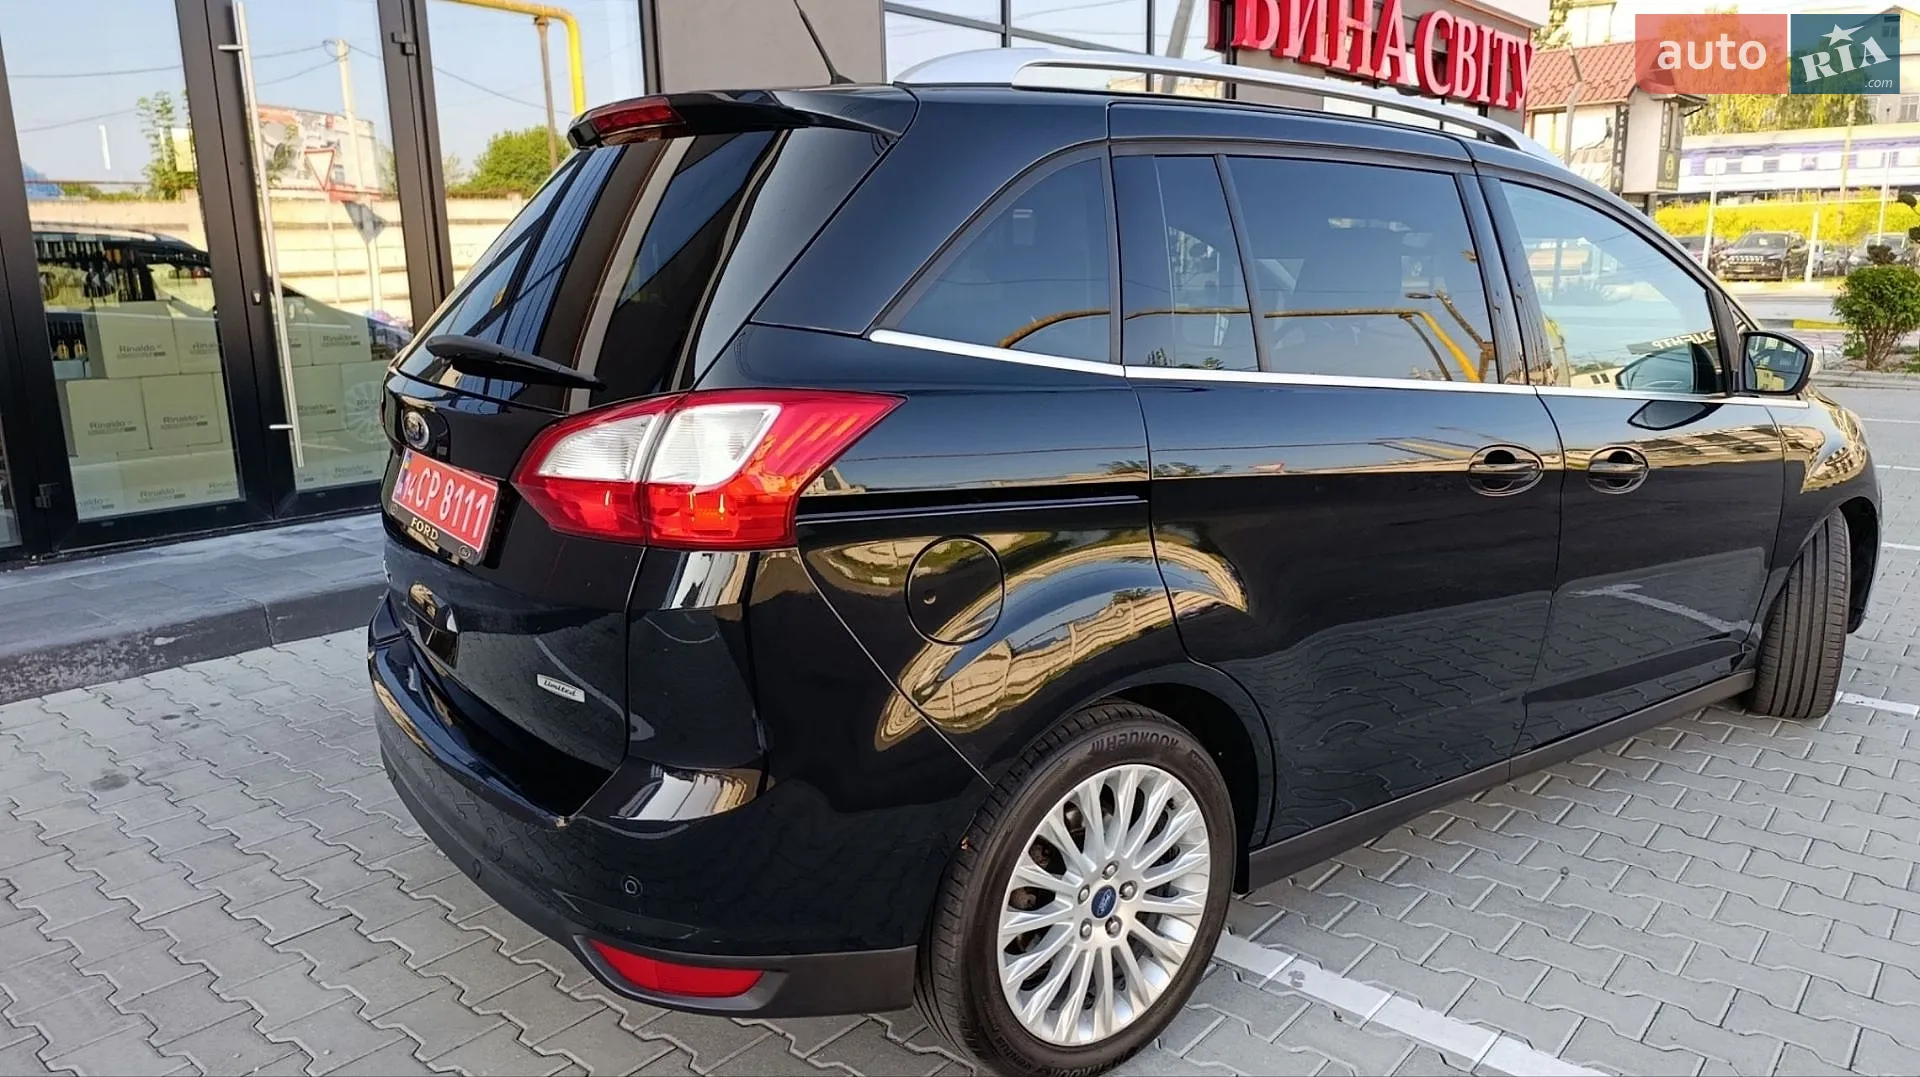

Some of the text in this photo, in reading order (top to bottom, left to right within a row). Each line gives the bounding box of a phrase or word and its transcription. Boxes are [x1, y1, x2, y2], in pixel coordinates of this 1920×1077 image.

[1417, 9, 1536, 109] СВІТУ
[118, 343, 156, 353] Rinaldo
[89, 419, 126, 430] Rinaldo
[163, 414, 198, 424] Rinaldo
[439, 477, 489, 539] 8111
[410, 517, 439, 541] FORD
